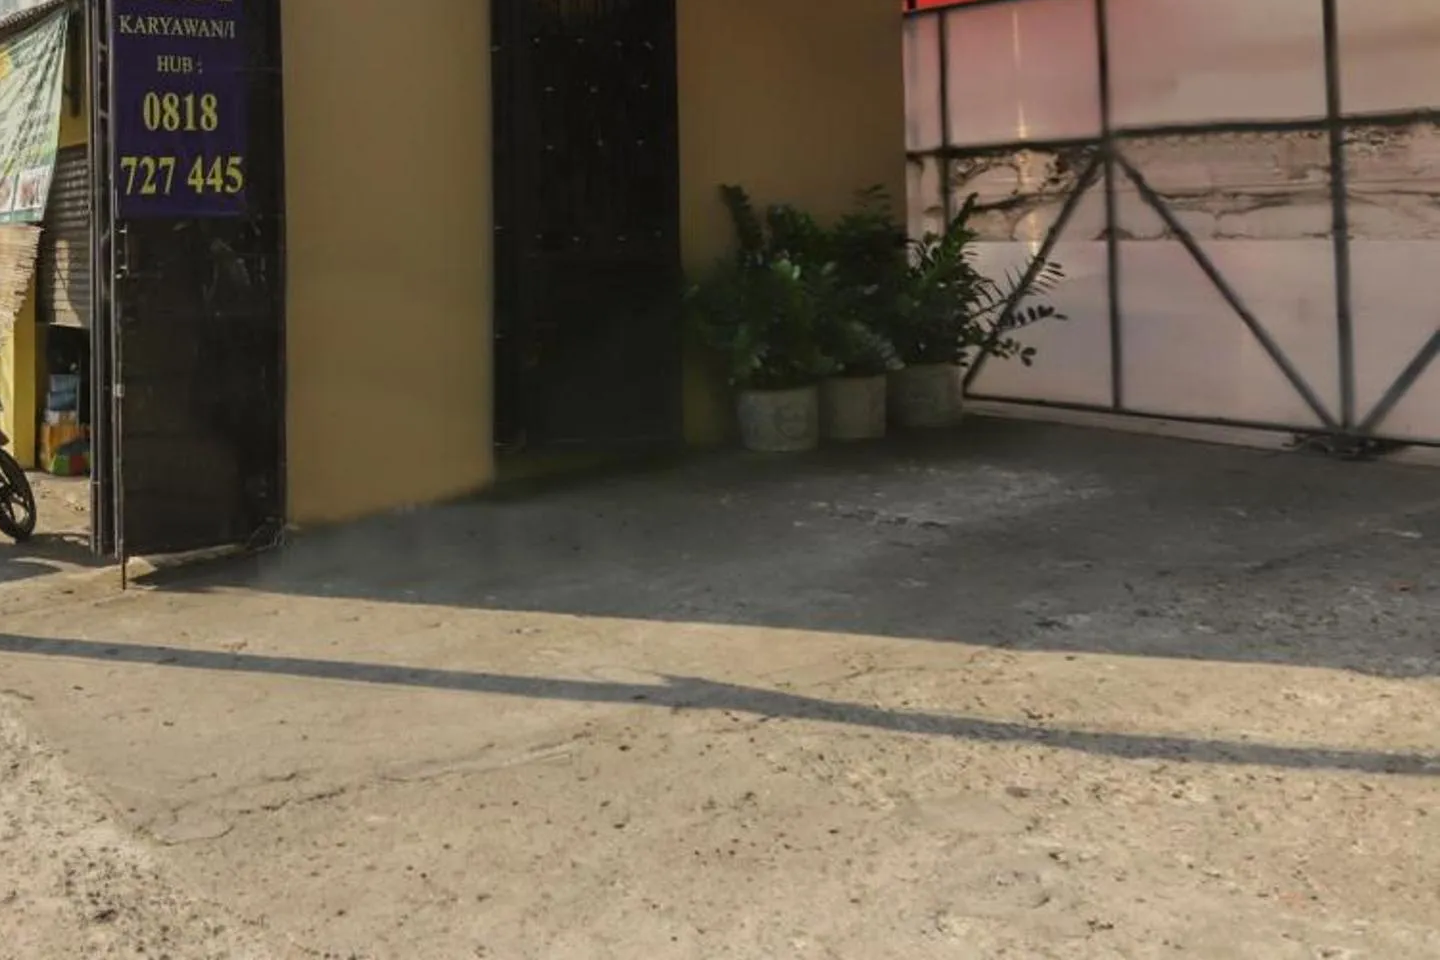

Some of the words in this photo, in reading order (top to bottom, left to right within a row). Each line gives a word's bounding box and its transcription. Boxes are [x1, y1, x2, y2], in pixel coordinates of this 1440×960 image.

[120, 15, 236, 39] KARYAWAN/I
[143, 92, 218, 132] 0818
[120, 155, 175, 196] 727
[187, 154, 244, 195] 445
